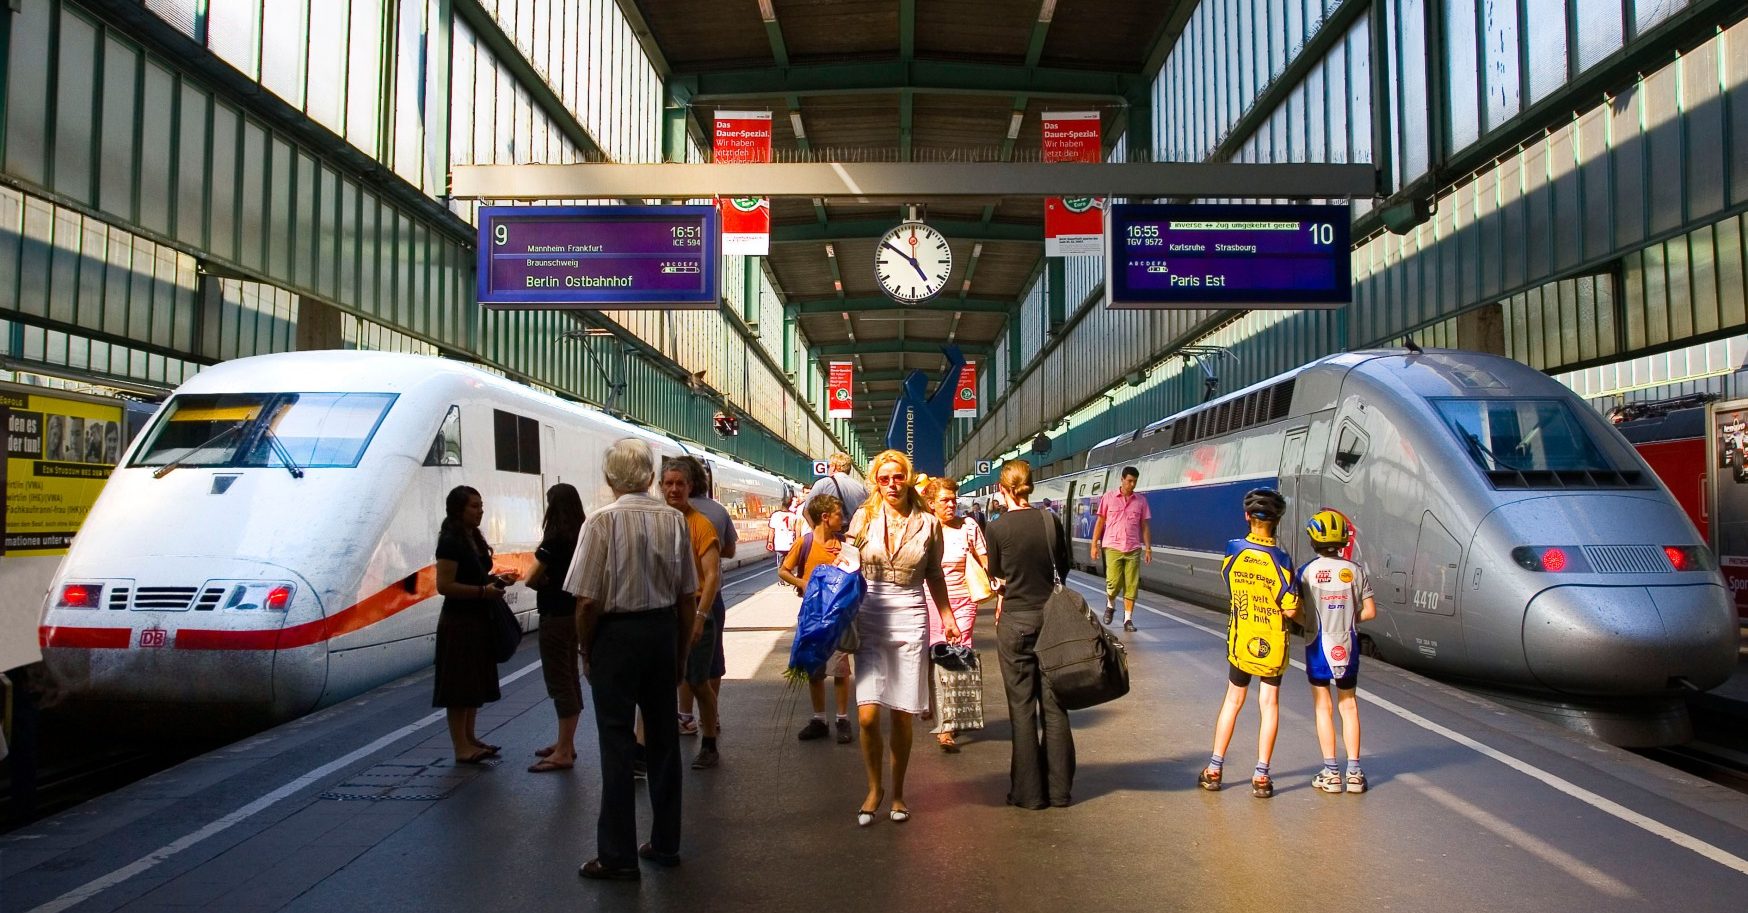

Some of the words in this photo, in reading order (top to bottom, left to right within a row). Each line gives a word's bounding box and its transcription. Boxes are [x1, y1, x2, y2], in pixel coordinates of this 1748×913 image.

[1044, 122, 1059, 130] Das
[716, 130, 770, 138] Dauer-Spezial.
[1044, 130, 1099, 139] Dauer-Spezial.
[716, 139, 729, 147] Wir
[730, 139, 755, 147] haben
[1044, 140, 1058, 148] Wir
[1059, 140, 1084, 148] haben
[734, 149, 749, 157] den
[1063, 149, 1079, 157] den
[494, 224, 508, 245] 9
[670, 226, 701, 238] 16:51
[1127, 225, 1159, 237] 16:55
[1308, 223, 1334, 245] 10
[673, 239, 685, 247] ICE
[687, 239, 701, 247] 594
[1126, 238, 1142, 246] TGV
[1144, 238, 1163, 246] 9572
[567, 244, 603, 252] Frankfurt
[1169, 243, 1206, 251] Karlsruhe
[1215, 243, 1257, 253] Strasbourg
[526, 259, 579, 269] Braunschweig
[526, 275, 560, 287] Berlin
[565, 275, 633, 287] Ostbahnhof
[1170, 275, 1200, 287] Paris
[1205, 275, 1226, 287] Est
[26, 418, 37, 433] es
[8, 435, 22, 452] der
[24, 437, 41, 453] tun!
[815, 463, 826, 474] G
[978, 462, 989, 473] G
[782, 516, 790, 529] 1
[43, 535, 62, 545] unter
[1243, 555, 1269, 567] Santini
[1256, 574, 1276, 586] EUROPE
[1413, 590, 1439, 610] 4410
[1253, 603, 1280, 616] hunger
